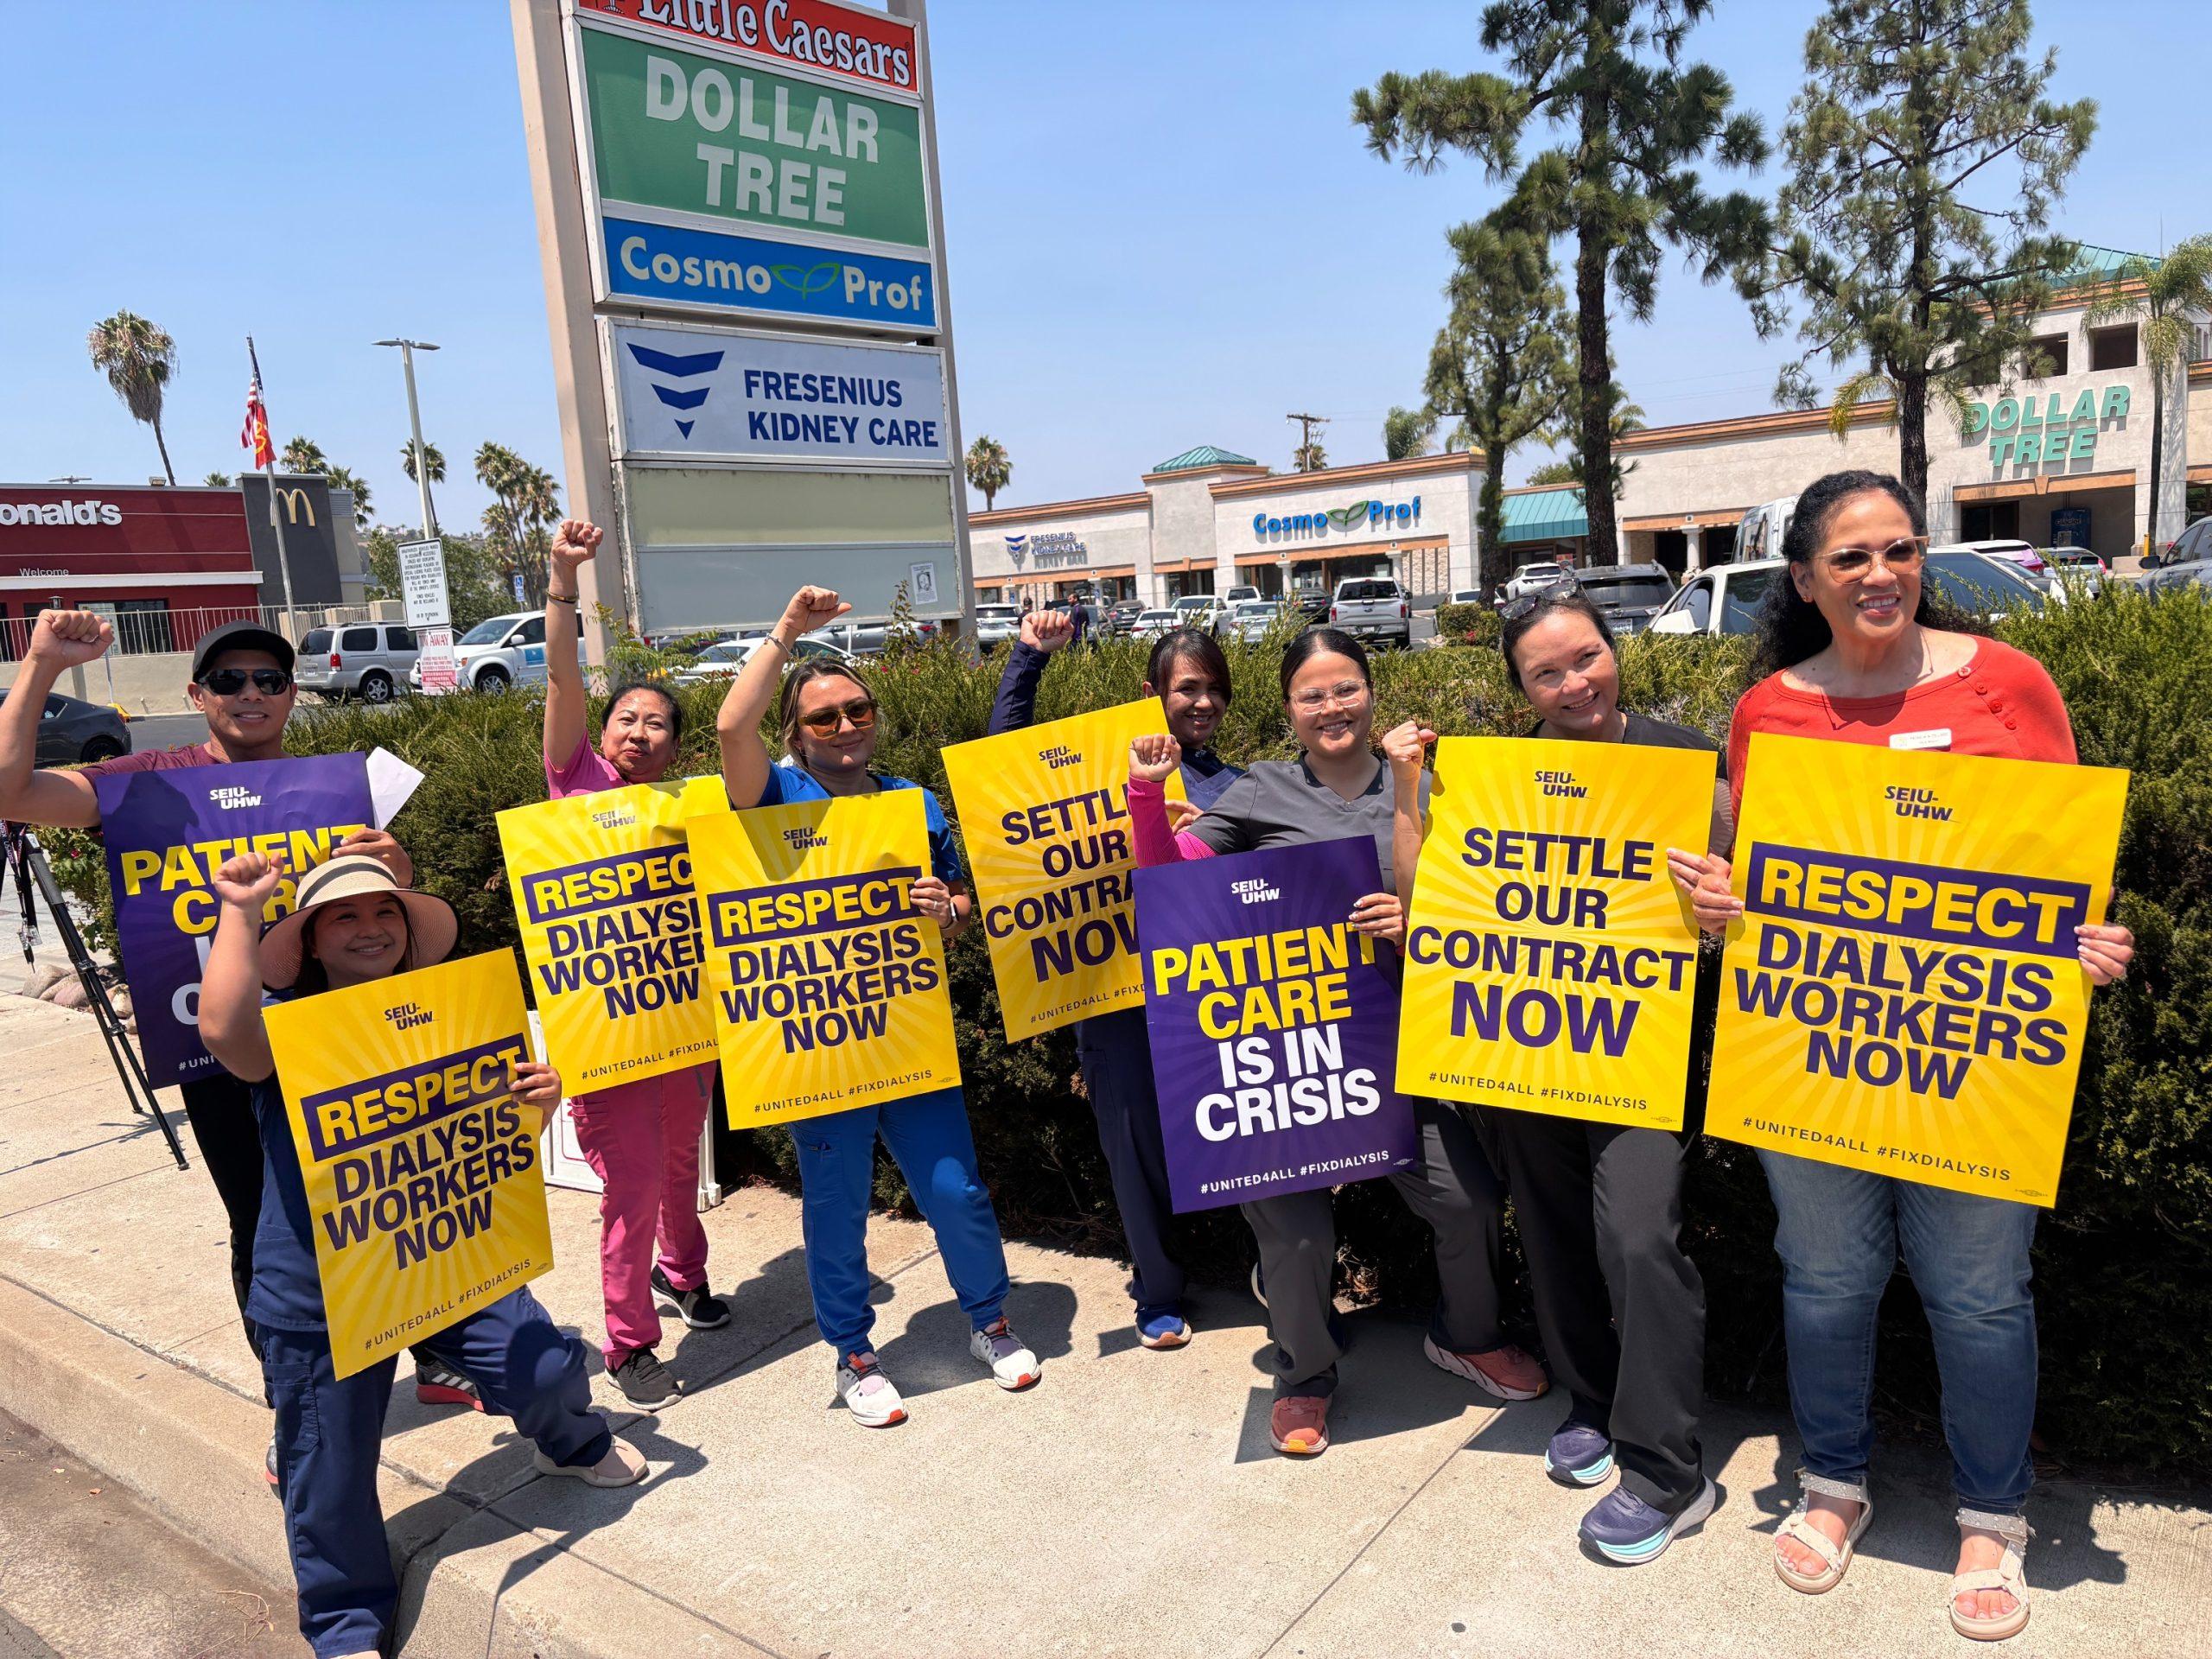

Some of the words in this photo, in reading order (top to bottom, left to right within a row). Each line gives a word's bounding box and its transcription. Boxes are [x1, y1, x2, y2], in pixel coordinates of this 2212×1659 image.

[766, 0, 911, 86] Caesars
[646, 55, 879, 163] DOLLAR
[697, 143, 847, 226] TREE
[620, 236, 772, 295] Cosmo
[842, 265, 922, 311] Prof
[744, 370, 902, 408] FRESENIUS
[1968, 385, 2131, 433] DOLLAR
[747, 411, 859, 443] KIDNEY
[868, 417, 938, 448] CARE
[1989, 427, 2098, 467] TREE
[1030, 531, 1075, 543] FRESENIUS
[1253, 512, 1328, 534] Cosmo
[1368, 496, 1421, 521] Prof
[19, 568, 69, 577] Welcome
[1064, 543, 1086, 552] CARE
[430, 633, 449, 646] AWAY
[1039, 746, 1071, 761] SEIU-
[1049, 753, 1082, 769] UHW
[1535, 770, 1576, 785] SEIU-
[210, 786, 250, 801] SEIU-
[220, 795, 262, 810] UHW
[1001, 783, 1130, 845] SETTL
[1543, 784, 1587, 798] UHW
[1884, 785, 1939, 804] SEIU-
[1895, 801, 1954, 822] UHW
[602, 815, 636, 830] UHW
[783, 826, 817, 842] SEIU-
[792, 836, 829, 851] UHW
[1042, 830, 1128, 878] OUR
[1462, 827, 1654, 881] SETTLE
[172, 877, 302, 934] CR
[532, 852, 693, 915] RESPEC
[718, 877, 916, 938] RESPECT
[985, 868, 1135, 939] CONTR
[1231, 879, 1268, 894] SEIU-
[1242, 888, 1280, 905] UHW
[1495, 881, 1608, 929] OUR
[1760, 857, 2075, 944] RESPECT
[545, 898, 701, 959] DIALYSI
[539, 933, 705, 995] WORKE
[728, 925, 921, 986] DIALYSIS
[1152, 922, 1376, 995] PATIENT
[1408, 925, 1694, 992] CONTRACT
[1757, 923, 2054, 1013] DIALYSIS
[385, 1002, 422, 1021] SEIU-
[604, 968, 699, 1020] NOW
[720, 957, 939, 1024] WORKERS
[1030, 993, 1109, 1024] #UNITED4ALL
[1198, 973, 1352, 1039] CARE
[396, 1012, 434, 1031] UHW
[782, 1003, 888, 1054] NOW
[1450, 981, 1641, 1058] NOW
[1734, 967, 2069, 1067] WORKERS
[582, 1052, 664, 1080] #UNITED4ALL
[669, 1039, 719, 1058] #FIXDIAL
[1217, 1037, 1274, 1089] IS
[1283, 1024, 1344, 1077] IN
[1806, 1029, 1973, 1101] NOW
[316, 1046, 521, 1148] RESPECT
[754, 1088, 844, 1113] #UNITED4ALL
[849, 1070, 933, 1096] #FIXDIALYSIS
[1195, 1068, 1381, 1142] CRISIS
[1429, 1071, 1535, 1096] #UNITED4ALL
[1541, 1087, 1648, 1110] #FIXDIALYSIS
[333, 1099, 520, 1205] DIALYSIS
[1200, 1168, 1296, 1194] #UNITED4ALL
[1300, 1150, 1389, 1176] #FIXDIALYSIS
[1743, 1116, 1869, 1154] #UNITED4ALL
[1877, 1145, 2012, 1181] #FIXDIALYSIS
[322, 1134, 536, 1251] WORKERS
[394, 1191, 493, 1271] NOW
[365, 1300, 455, 1351] #UNITED4ALL
[459, 1258, 531, 1305] #FIXDIALYSIS
